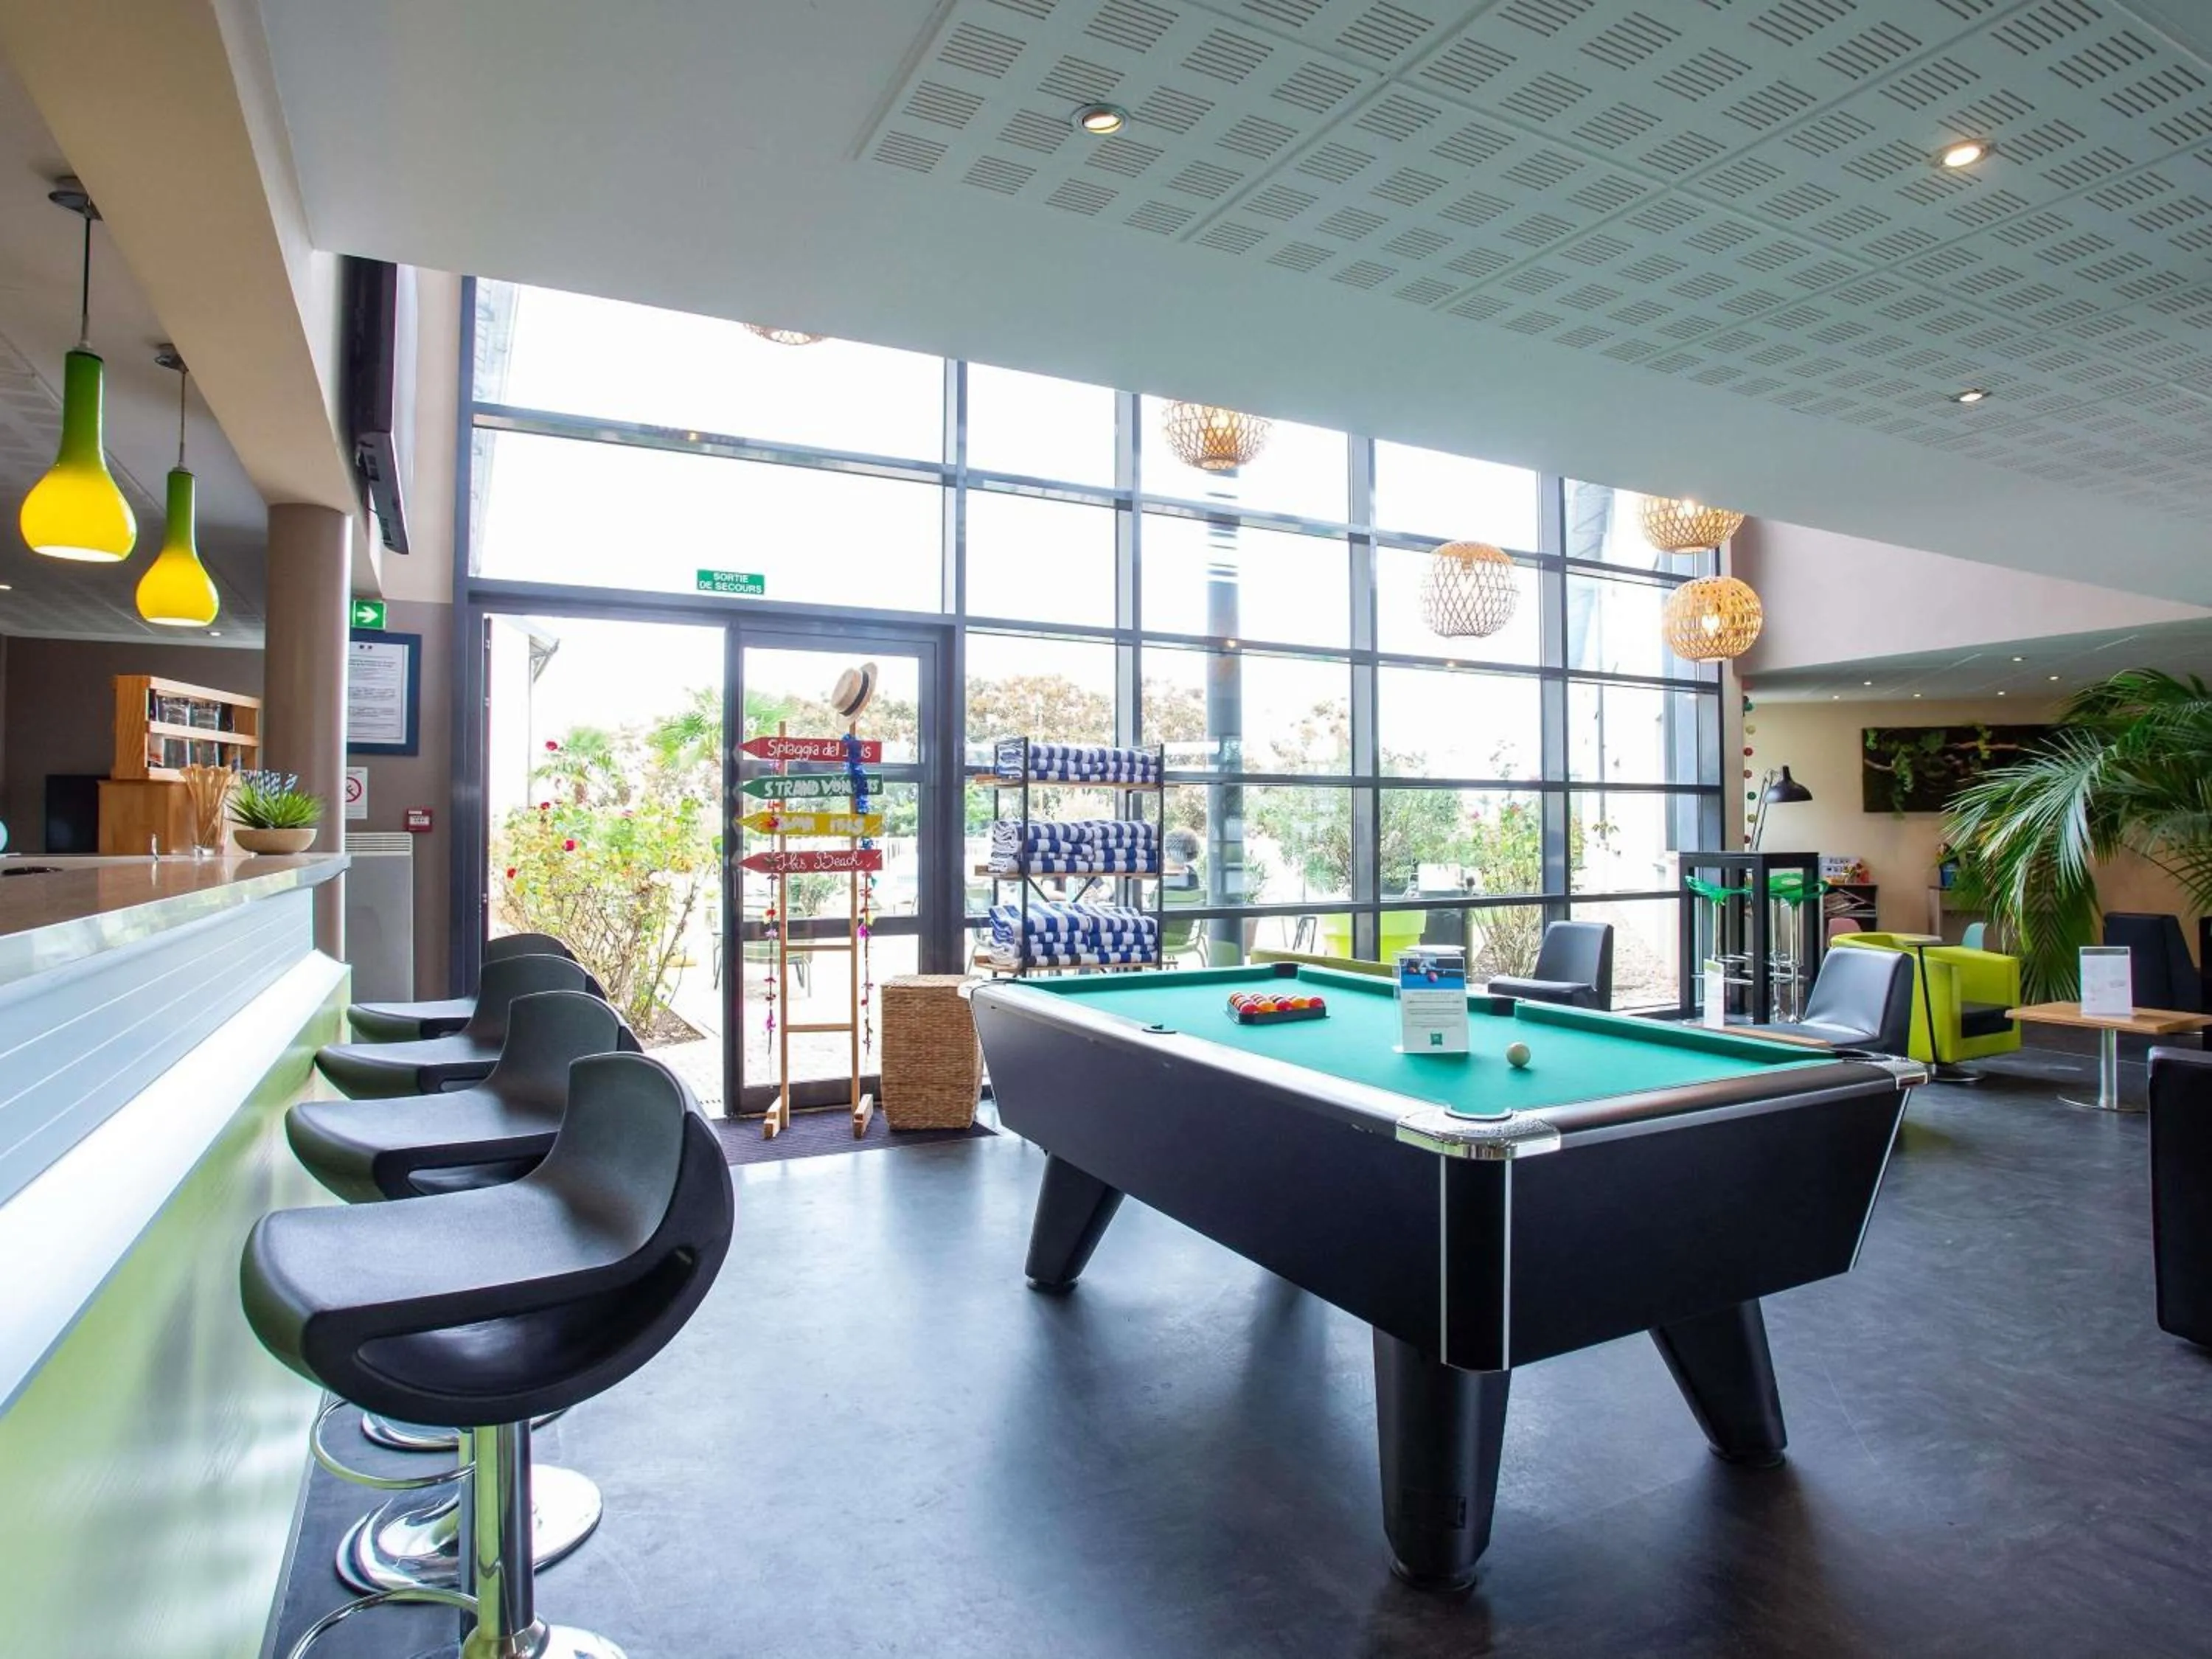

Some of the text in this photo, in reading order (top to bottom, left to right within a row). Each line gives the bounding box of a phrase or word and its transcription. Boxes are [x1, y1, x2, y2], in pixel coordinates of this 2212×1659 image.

[713, 572, 749, 583] SORTIE
[699, 580, 762, 594] DE SECOURS
[767, 739, 819, 762] Spiaggia
[822, 742, 840, 757] del
[764, 779, 819, 797] STRAND
[813, 851, 863, 869] Beach
